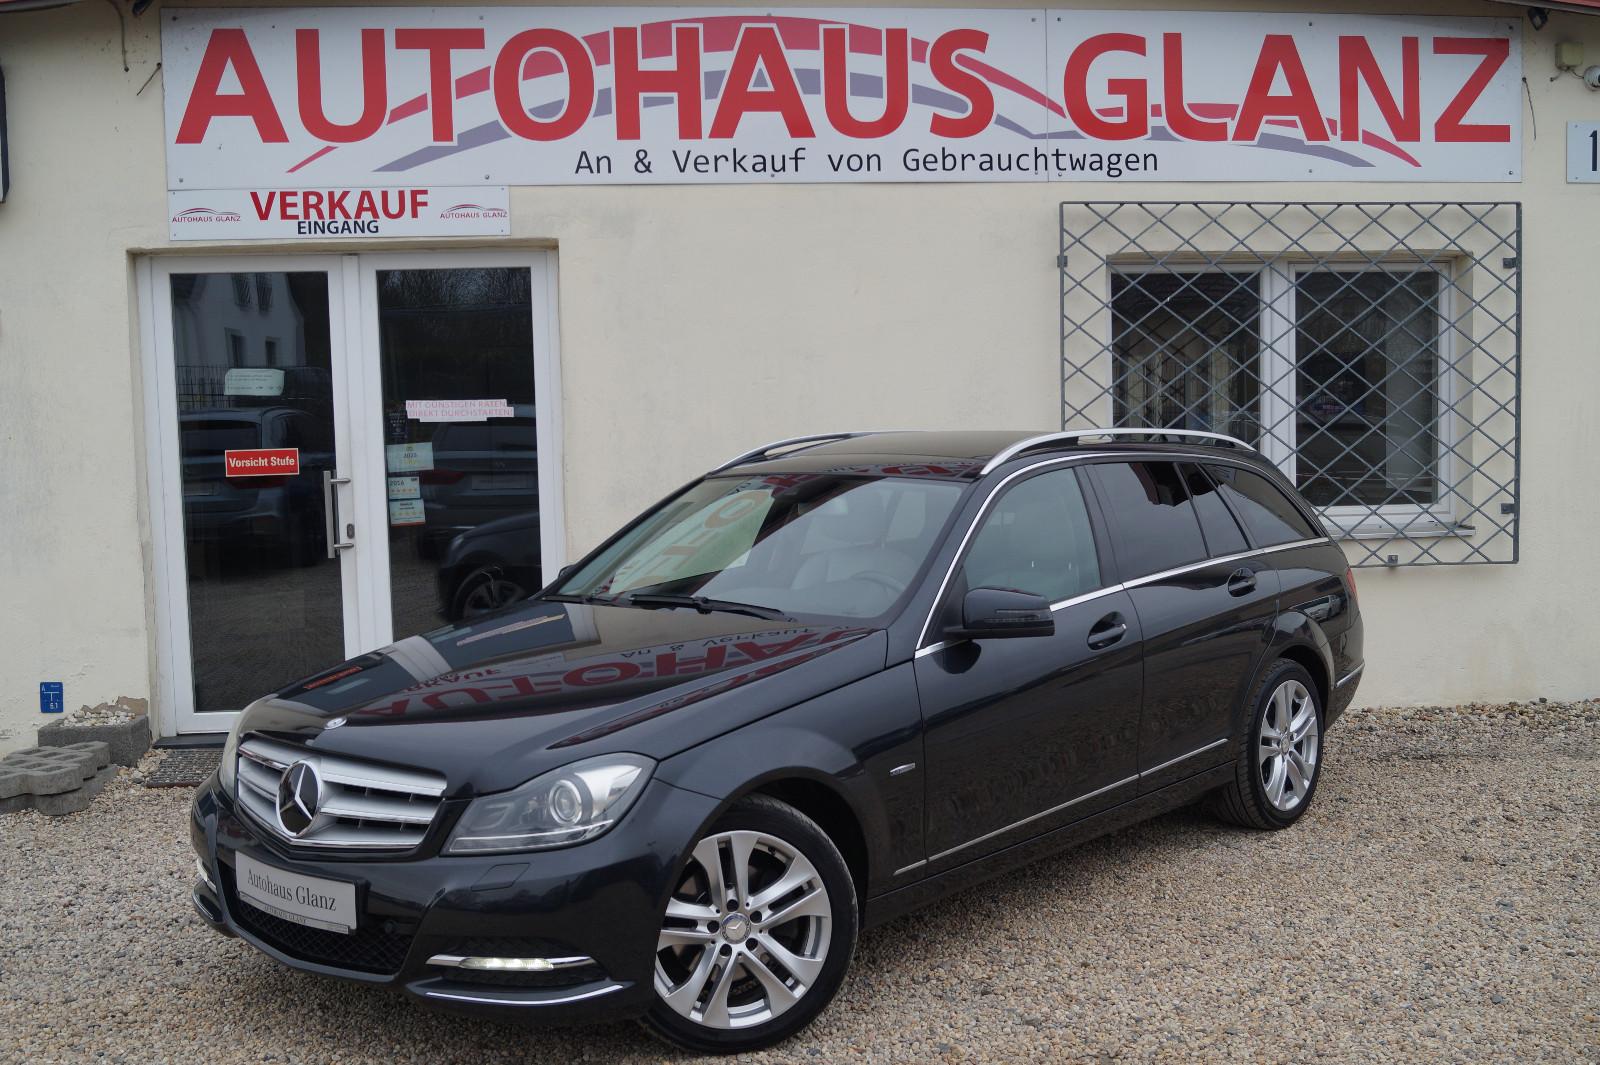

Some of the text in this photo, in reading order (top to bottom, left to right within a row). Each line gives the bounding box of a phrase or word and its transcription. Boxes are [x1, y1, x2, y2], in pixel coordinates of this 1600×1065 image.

[175, 26, 1512, 145] AUTOHAUS GLANZ
[576, 148, 1158, 179] An & Verkauf von Gebrauchtwagen
[250, 190, 428, 221] VERKAUF
[440, 211, 480, 219] AUTOHAUS
[172, 215, 213, 223] AUTOHAUS
[297, 219, 379, 235] EINGANG
[229, 455, 295, 468] Vorsicht Stufe
[247, 868, 337, 911] Autohaus Glanz
